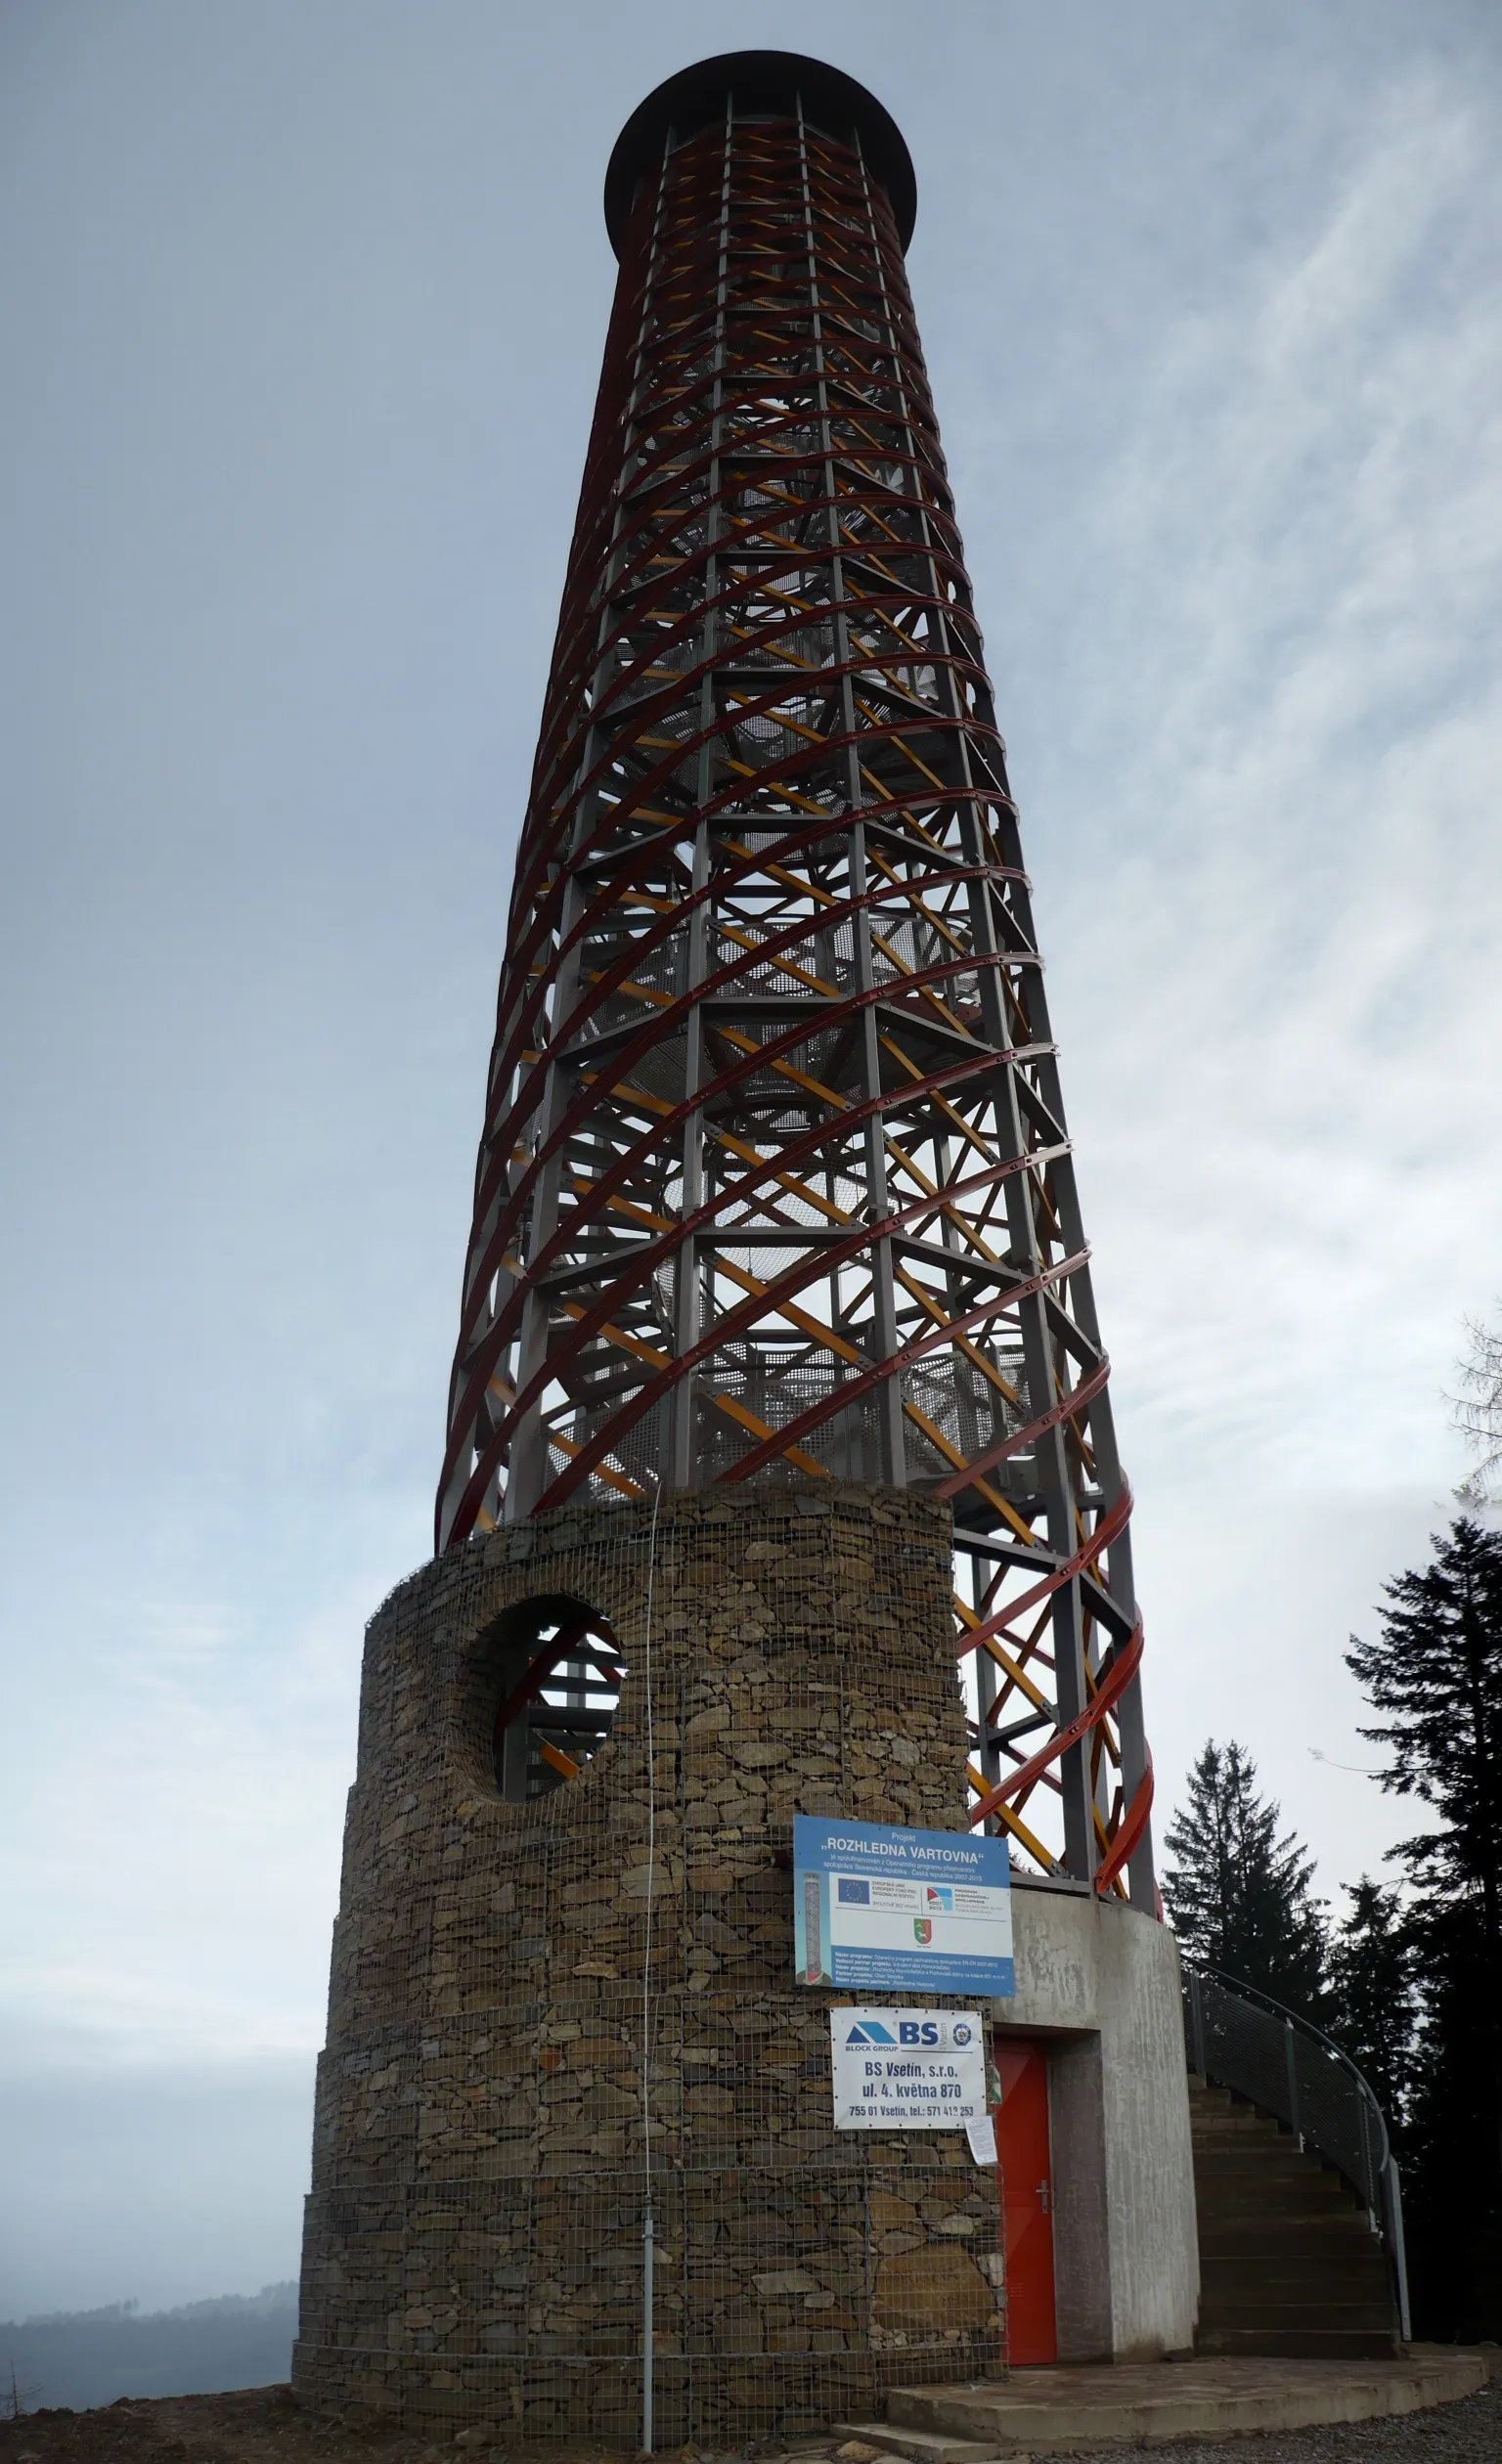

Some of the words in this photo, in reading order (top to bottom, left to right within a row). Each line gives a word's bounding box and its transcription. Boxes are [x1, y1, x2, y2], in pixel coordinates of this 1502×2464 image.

[891, 1832, 916, 1843] Projekt
[821, 1837, 907, 1858] „ROZHLEDNA
[909, 1846, 985, 1865] VARTOVNA“
[899, 2021, 939, 2046] BS
[864, 2061, 882, 2077] BS
[886, 2062, 925, 2080] Vsetín,
[929, 2065, 958, 2078] s.r.o.
[862, 2084, 877, 2098] ul.
[881, 2084, 893, 2098] 4.
[896, 2084, 937, 2098] května
[940, 2084, 962, 2098] 870
[849, 2106, 866, 2117] 755
[868, 2106, 878, 2117] 01
[880, 2106, 908, 2118] Vsetín,
[909, 2106, 925, 2117] tel.:
[927, 2106, 941, 2117] 571
[960, 2107, 974, 2117] 253
